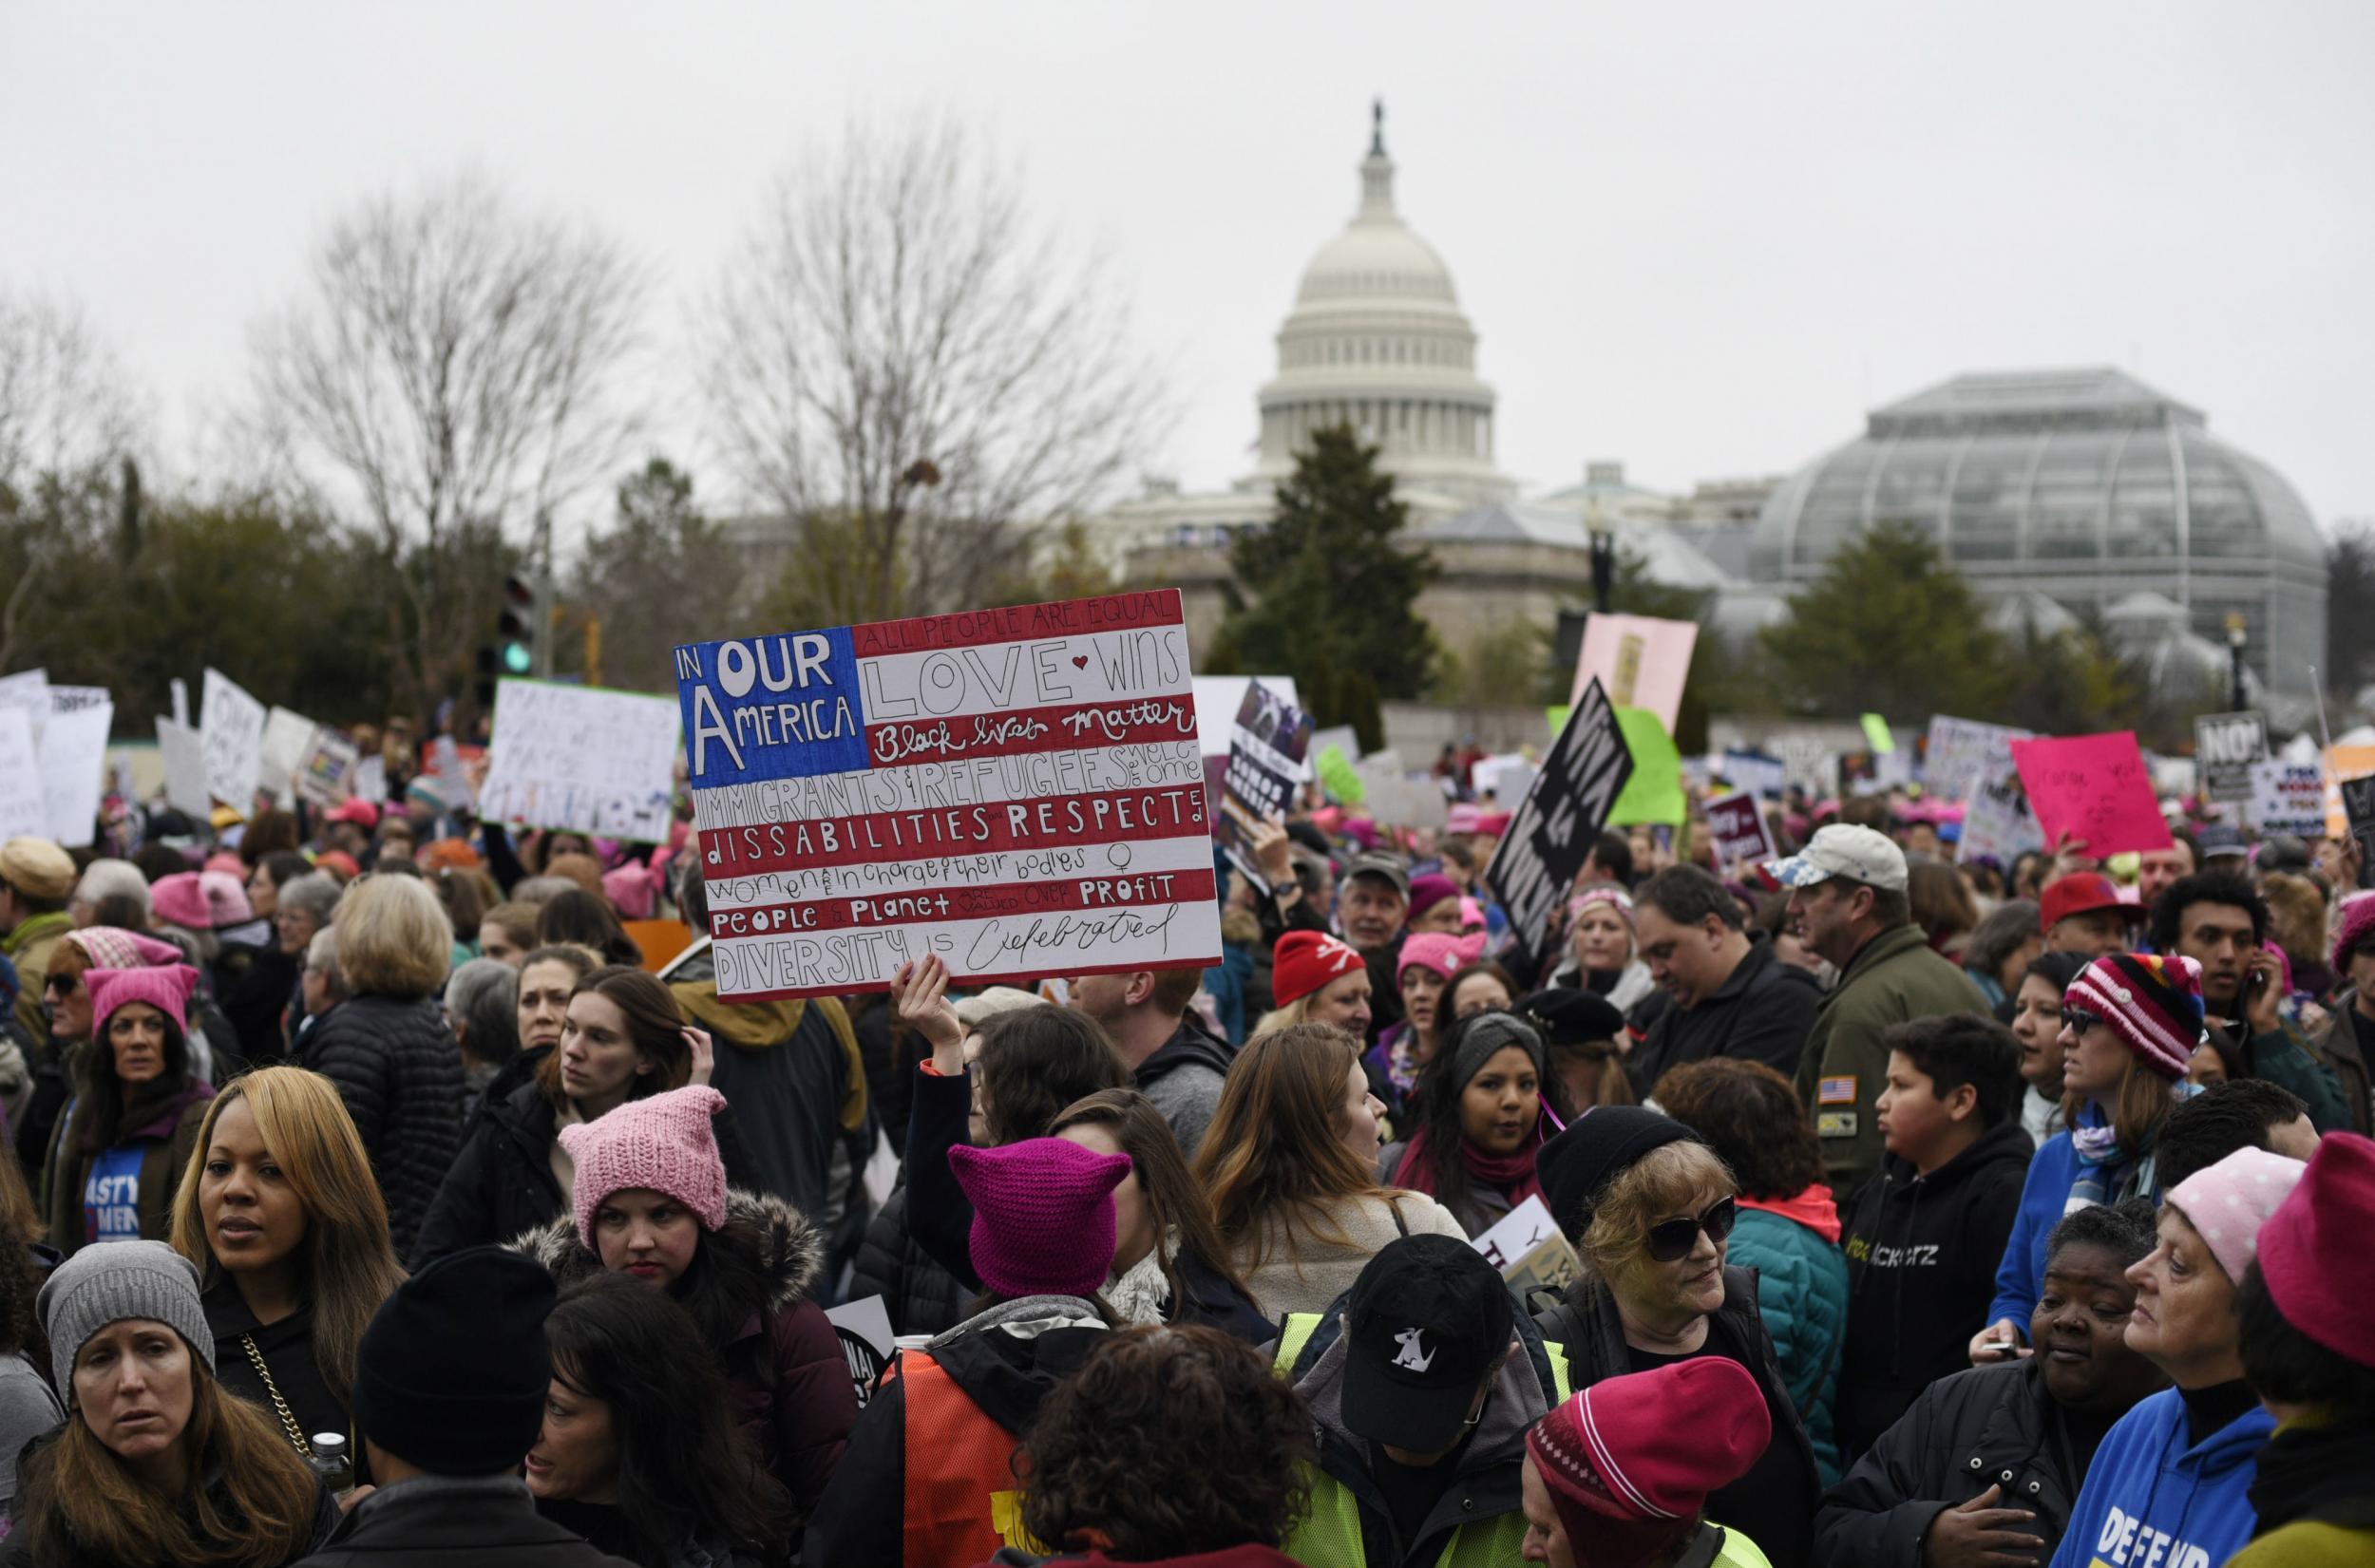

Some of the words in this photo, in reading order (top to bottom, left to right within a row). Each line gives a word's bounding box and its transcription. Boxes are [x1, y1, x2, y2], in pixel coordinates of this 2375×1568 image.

[862, 624, 914, 652] ALL
[922, 608, 1021, 643] PEOPLE
[1032, 602, 1079, 631] ARE
[1088, 592, 1174, 624] EQUAL
[674, 646, 703, 681] IN
[716, 633, 834, 699] OUR
[864, 640, 1073, 720] LOVE
[873, 720, 967, 764] Black
[694, 765, 902, 831] IMMIGRANTS
[916, 745, 1131, 810] REFUGEES
[952, 853, 1009, 883] their
[1015, 847, 1086, 880] bodies
[965, 902, 1179, 972] Celebrated
[85, 1173, 140, 1205] ASTY
[2097, 1505, 2210, 1568] DEFEND
